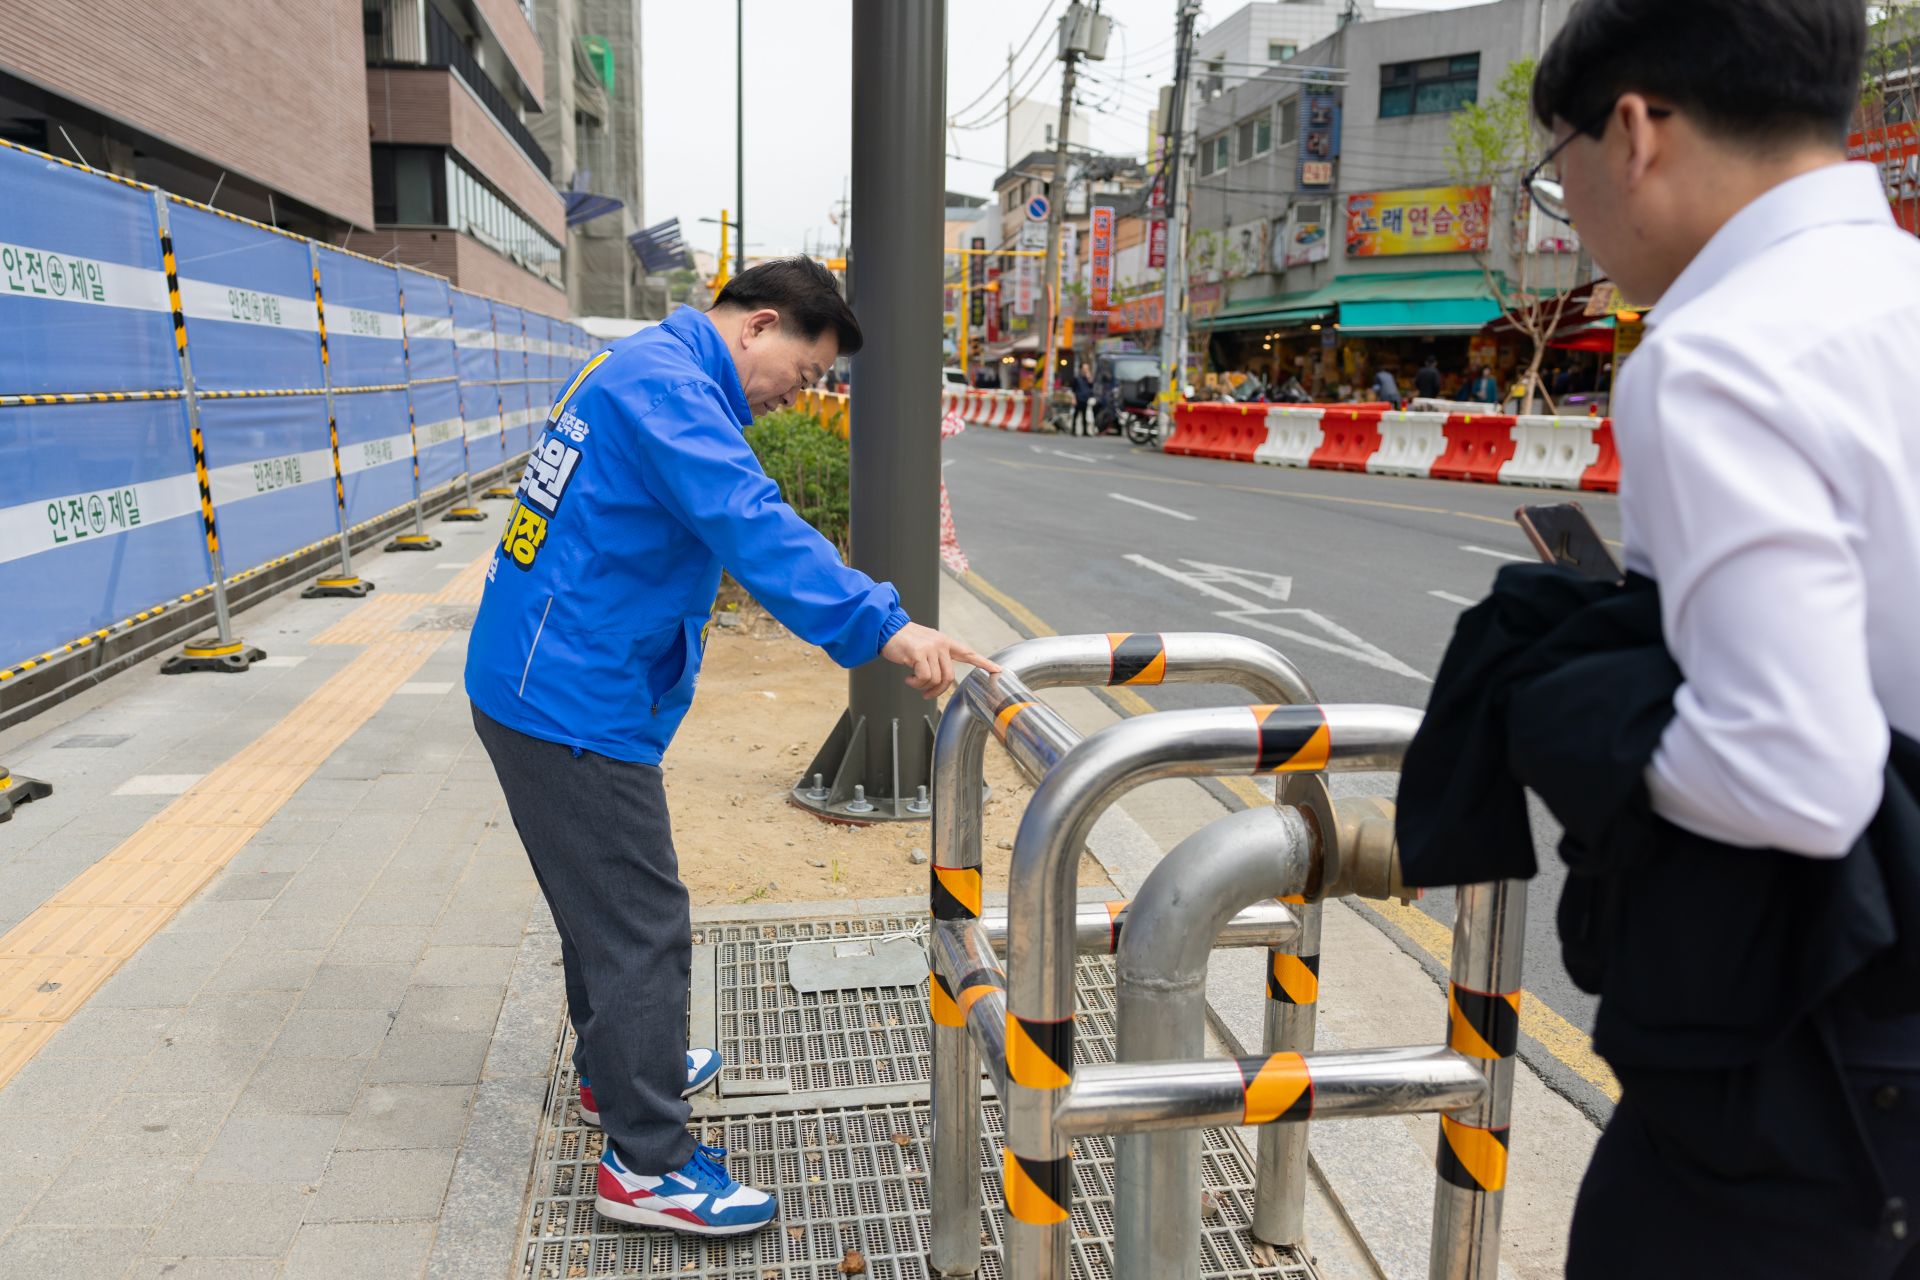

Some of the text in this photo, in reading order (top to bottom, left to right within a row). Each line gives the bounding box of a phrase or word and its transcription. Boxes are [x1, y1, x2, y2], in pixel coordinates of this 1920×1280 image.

[3, 248, 105, 301] 안전 제일
[228, 289, 282, 325] 안전 제일
[253, 457, 302, 492] 안전 제일
[48, 487, 141, 543] 안전 제일
